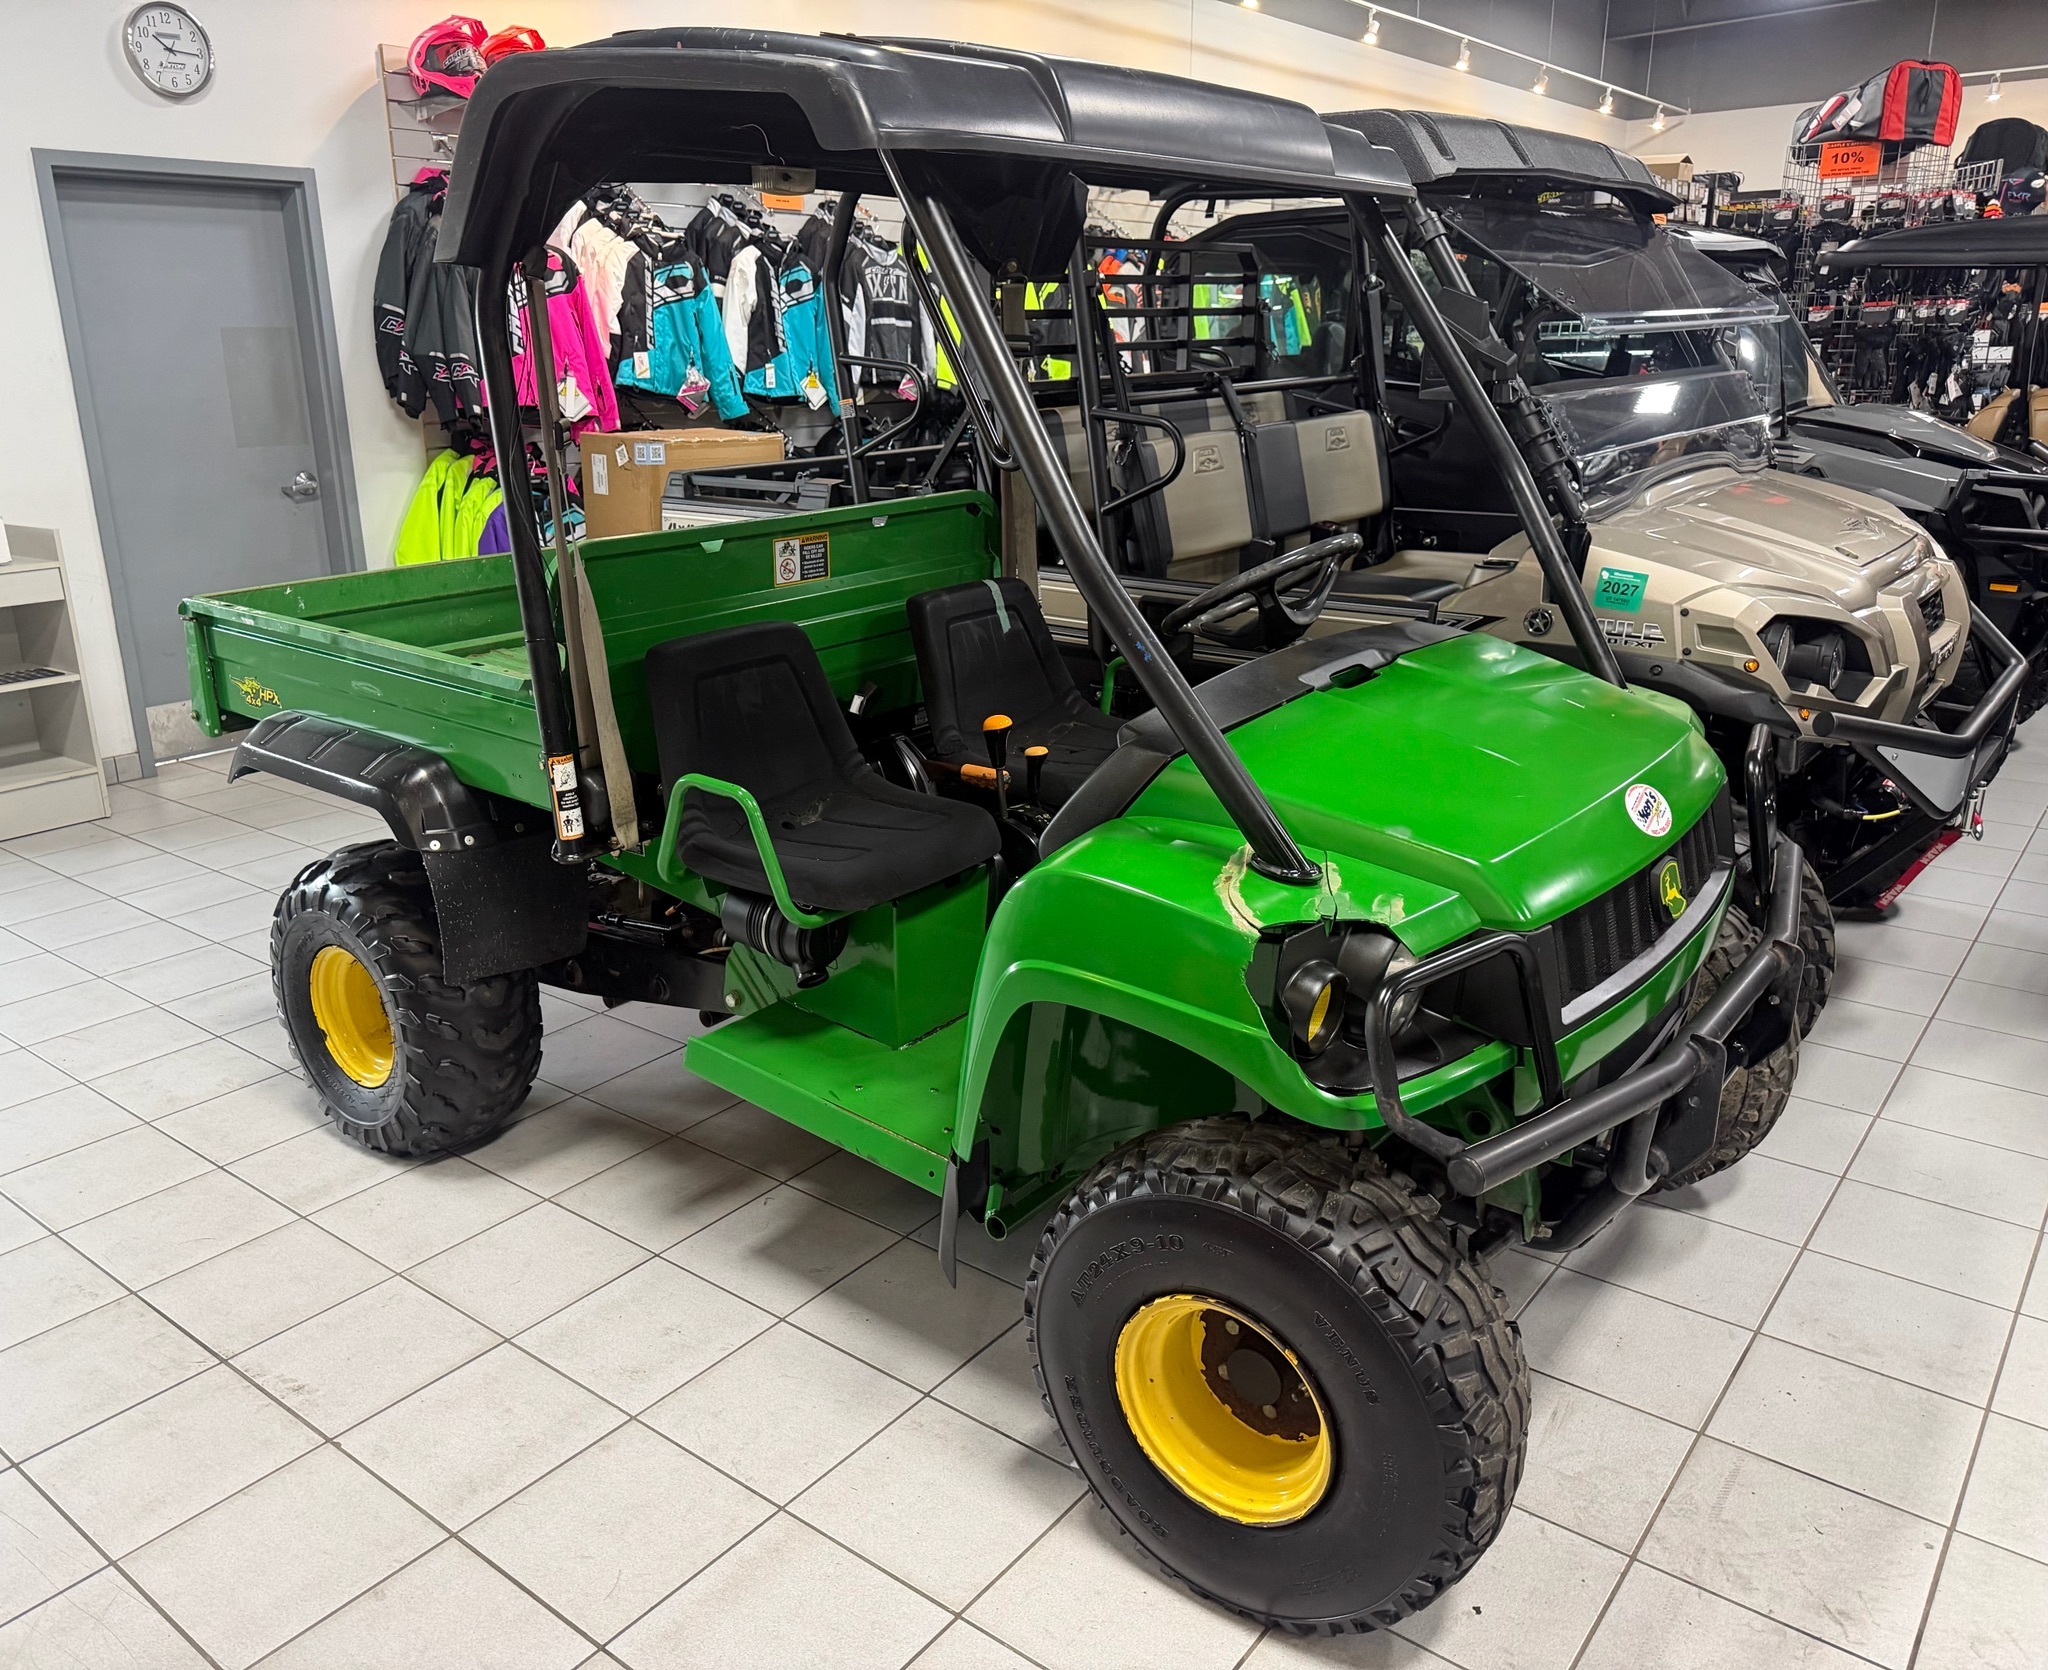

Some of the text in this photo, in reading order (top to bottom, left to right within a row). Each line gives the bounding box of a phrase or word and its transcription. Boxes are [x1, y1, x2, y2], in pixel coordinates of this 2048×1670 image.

[146, 15, 157, 27] 11
[159, 12, 171, 24] 12
[177, 18, 183, 30] 1
[137, 26, 149, 38] 10
[189, 31, 196, 42] 2
[135, 41, 142, 53] 9
[196, 48, 203, 60] 3
[142, 58, 150, 70] 8
[194, 64, 200, 75] 4
[156, 71, 162, 82] 7
[171, 77, 178, 88] 6
[185, 74, 192, 85] 5
[1831, 151, 1864, 164] 10%
[1601, 580, 1639, 596] 2027
[1597, 618, 1667, 643] ULE
[246, 695, 262, 707] 4x4
[259, 688, 281, 705] HPX
[1920, 842, 1947, 865] WARN
[1880, 883, 1906, 906] WARN
[1070, 1233, 1185, 1308] AT24X9-10
[1313, 1310, 1380, 1406] VENUS
